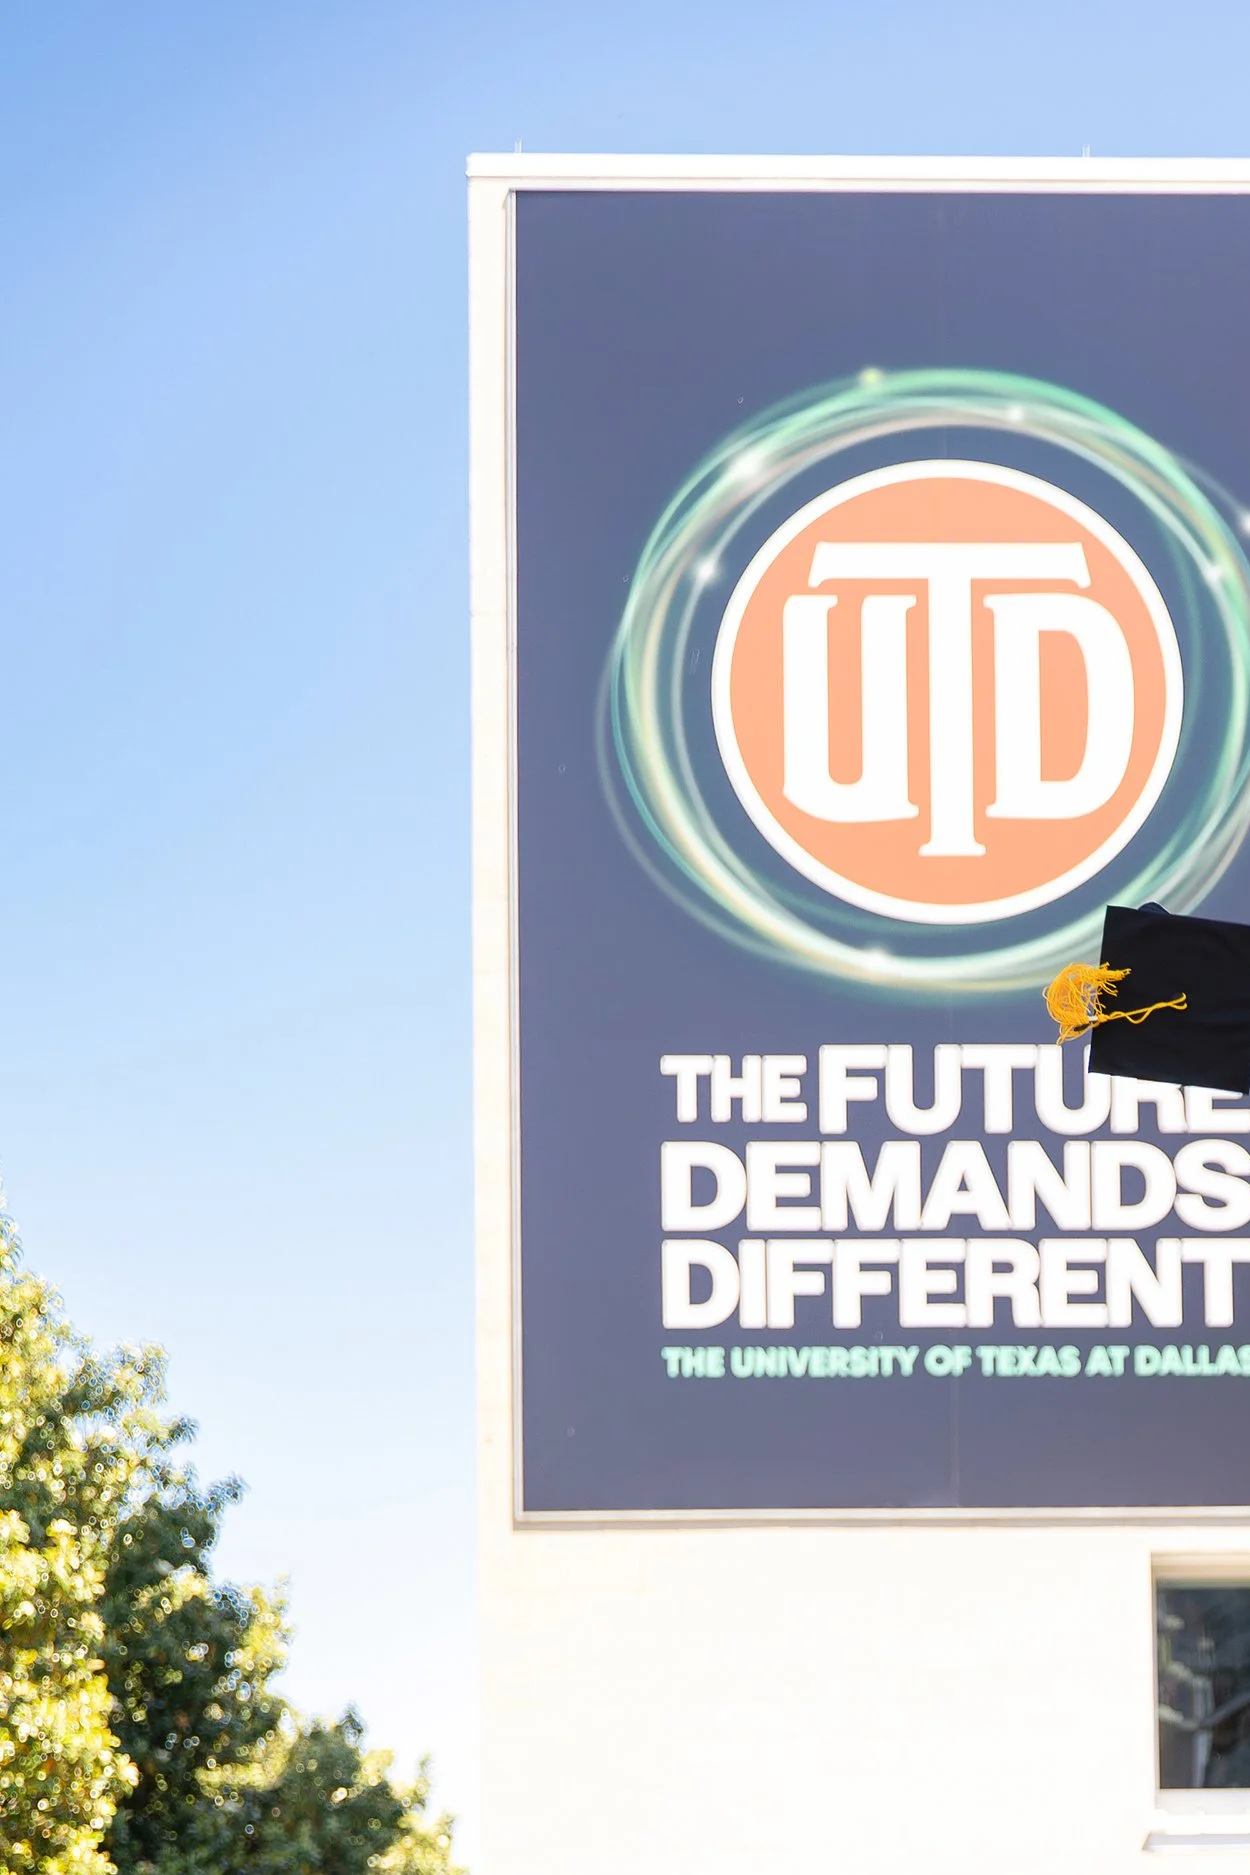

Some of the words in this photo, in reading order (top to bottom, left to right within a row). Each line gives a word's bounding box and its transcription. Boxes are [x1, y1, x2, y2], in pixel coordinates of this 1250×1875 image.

[783, 541, 1135, 856] UTD
[661, 1054, 807, 1123] THE
[661, 1346, 725, 1378] THE
[730, 1345, 920, 1378] UNIVERSITY
[924, 1345, 972, 1377] OF
[975, 1345, 1082, 1377] TEXAS
[1084, 1345, 1130, 1377] AT
